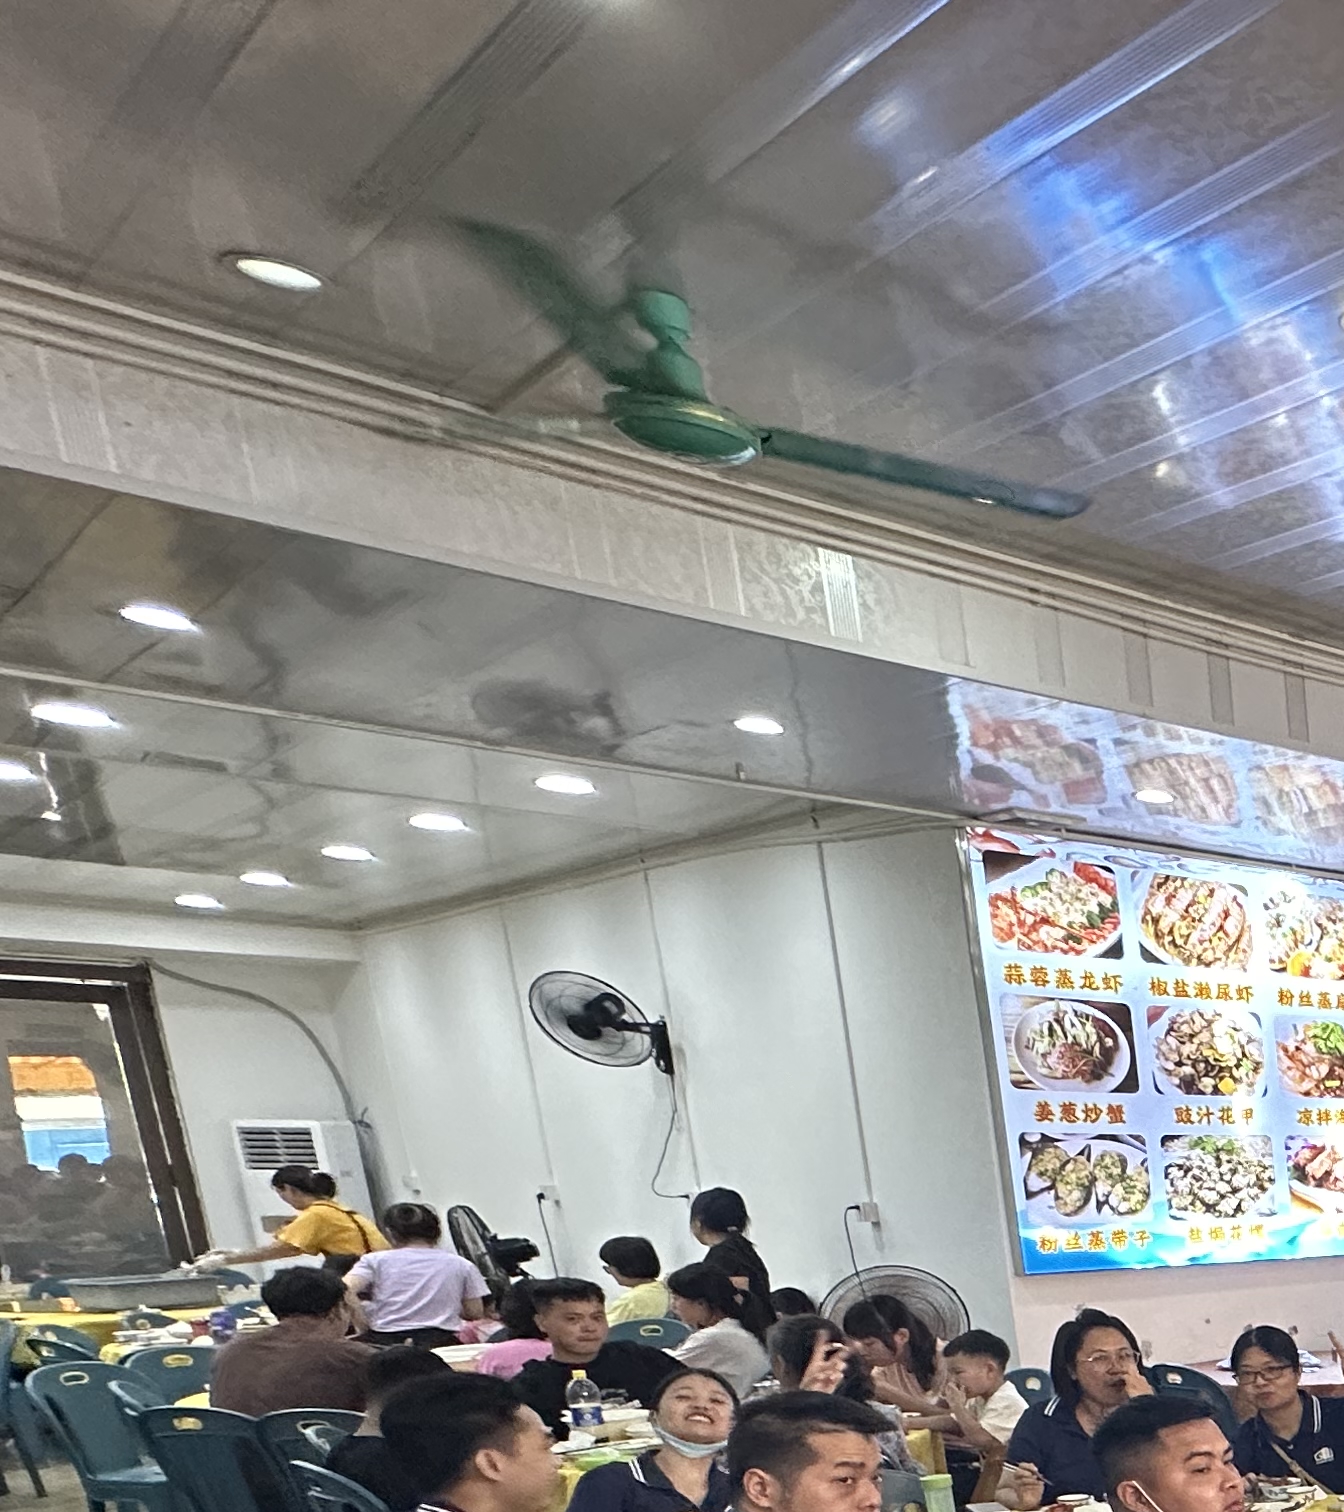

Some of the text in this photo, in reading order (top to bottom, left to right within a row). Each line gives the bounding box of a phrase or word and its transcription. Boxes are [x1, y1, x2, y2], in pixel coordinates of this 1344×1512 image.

[1003, 963, 1124, 995] 蒜蓉蒸龙虾
[1148, 976, 1254, 1004] 椒盐濑尿虾
[1033, 1100, 1127, 1125] 姜葱炒蟹
[1039, 1229, 1151, 1253] 粉丝蒸带子
